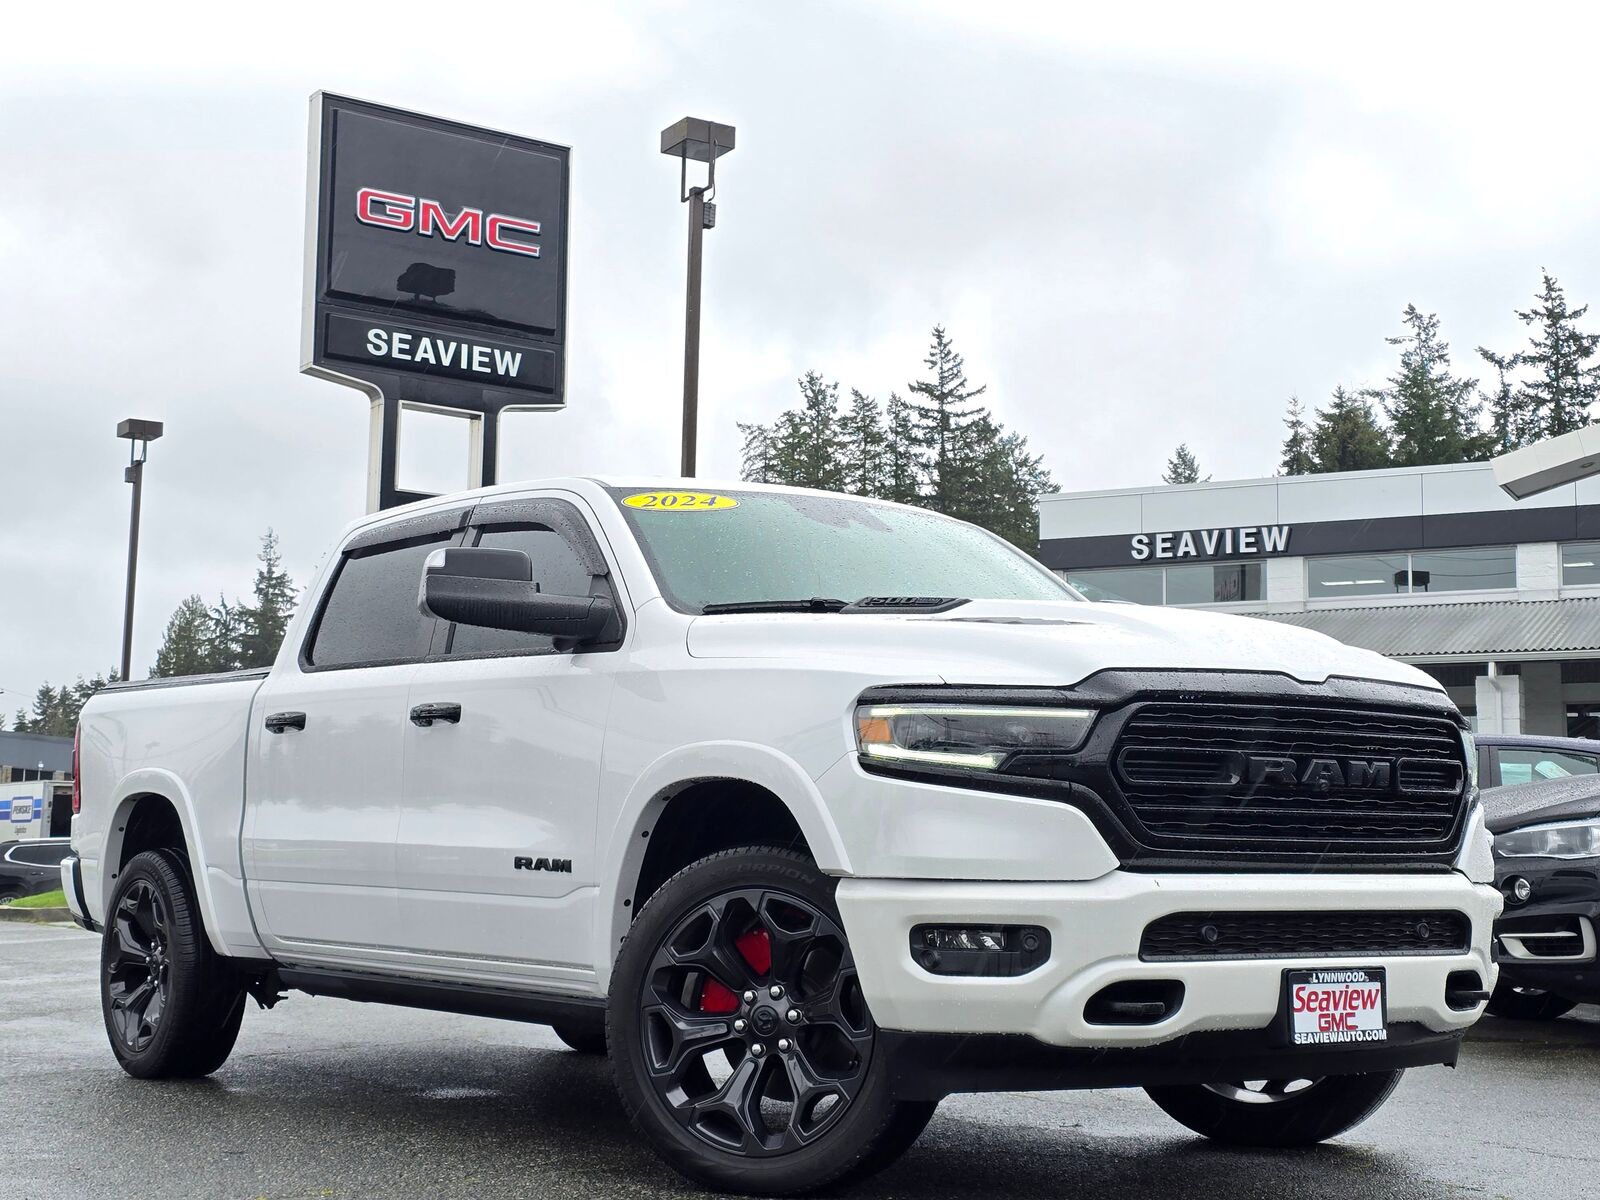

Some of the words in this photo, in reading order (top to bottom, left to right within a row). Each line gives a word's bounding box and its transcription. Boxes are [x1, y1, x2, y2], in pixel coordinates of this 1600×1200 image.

[356, 187, 541, 257] GMC
[366, 328, 522, 378] SEAVIEW
[641, 495, 718, 507] 2024
[1131, 525, 1291, 561] SEAVIEW
[1248, 755, 1392, 787] RAM
[514, 856, 572, 873] RAM
[1312, 971, 1365, 983] LYNNWOOD
[1293, 985, 1380, 1013] Seaview
[1318, 1012, 1358, 1032] GMC
[1294, 1029, 1387, 1044] SEAVIEWAUTO.COM
